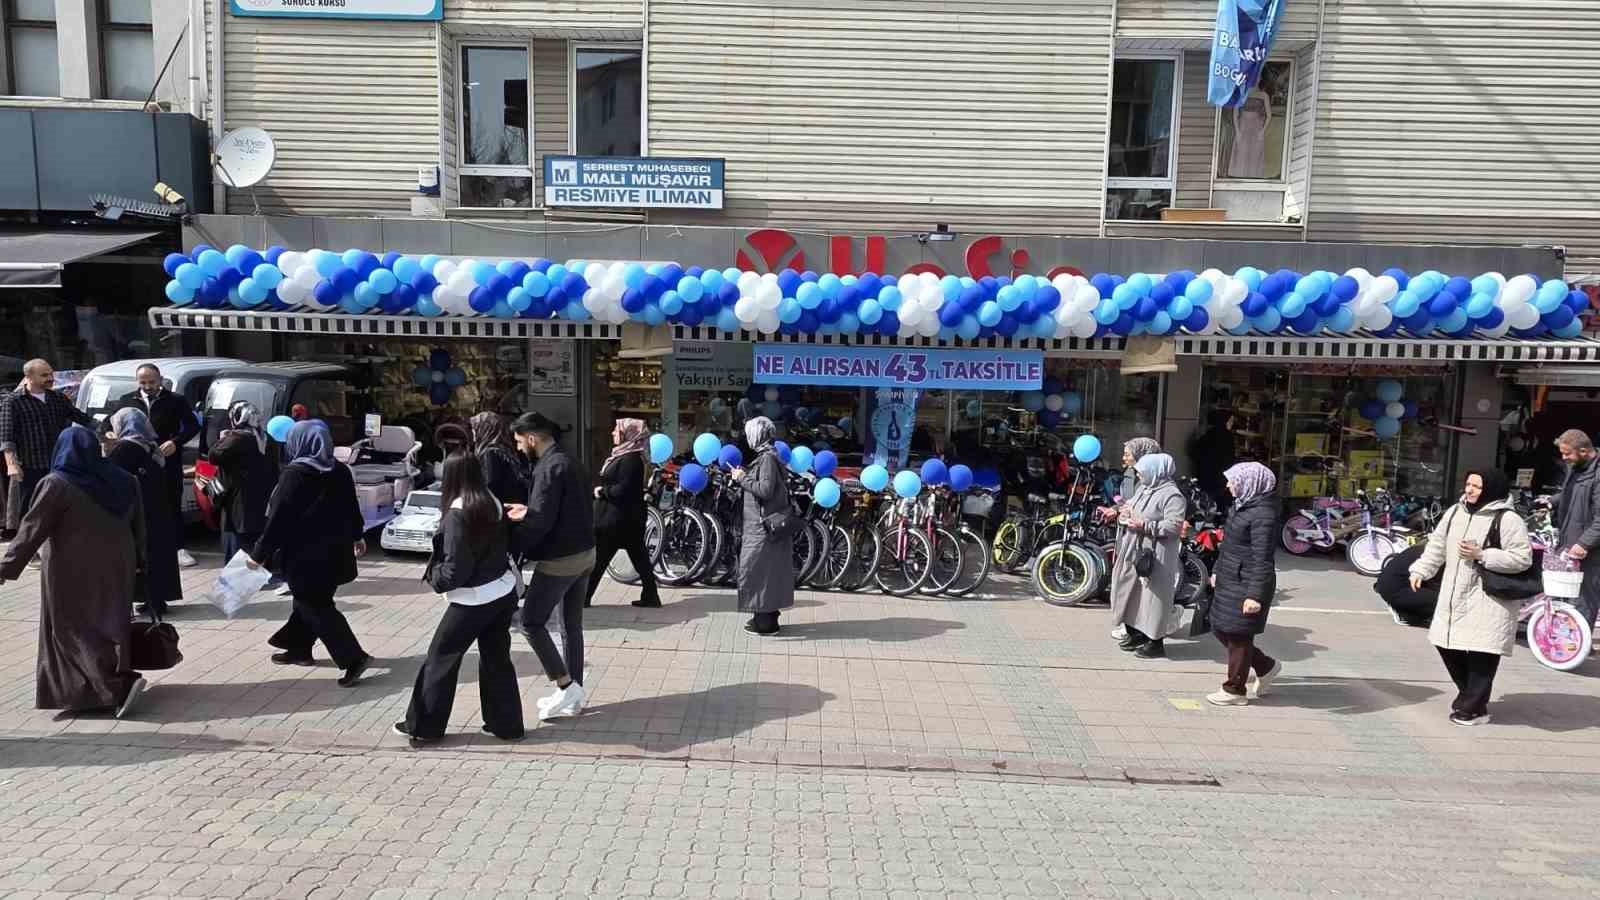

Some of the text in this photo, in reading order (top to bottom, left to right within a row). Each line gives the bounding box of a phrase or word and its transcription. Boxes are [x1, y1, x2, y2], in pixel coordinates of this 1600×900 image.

[583, 163, 635, 172] SERBEST
[646, 190, 712, 204] ILIMAN
[755, 355, 785, 375] NE
[789, 356, 881, 377] ALIRSAN
[883, 352, 928, 383] 43
[928, 369, 941, 380] TL
[941, 356, 1041, 381] TAKSİTLE
